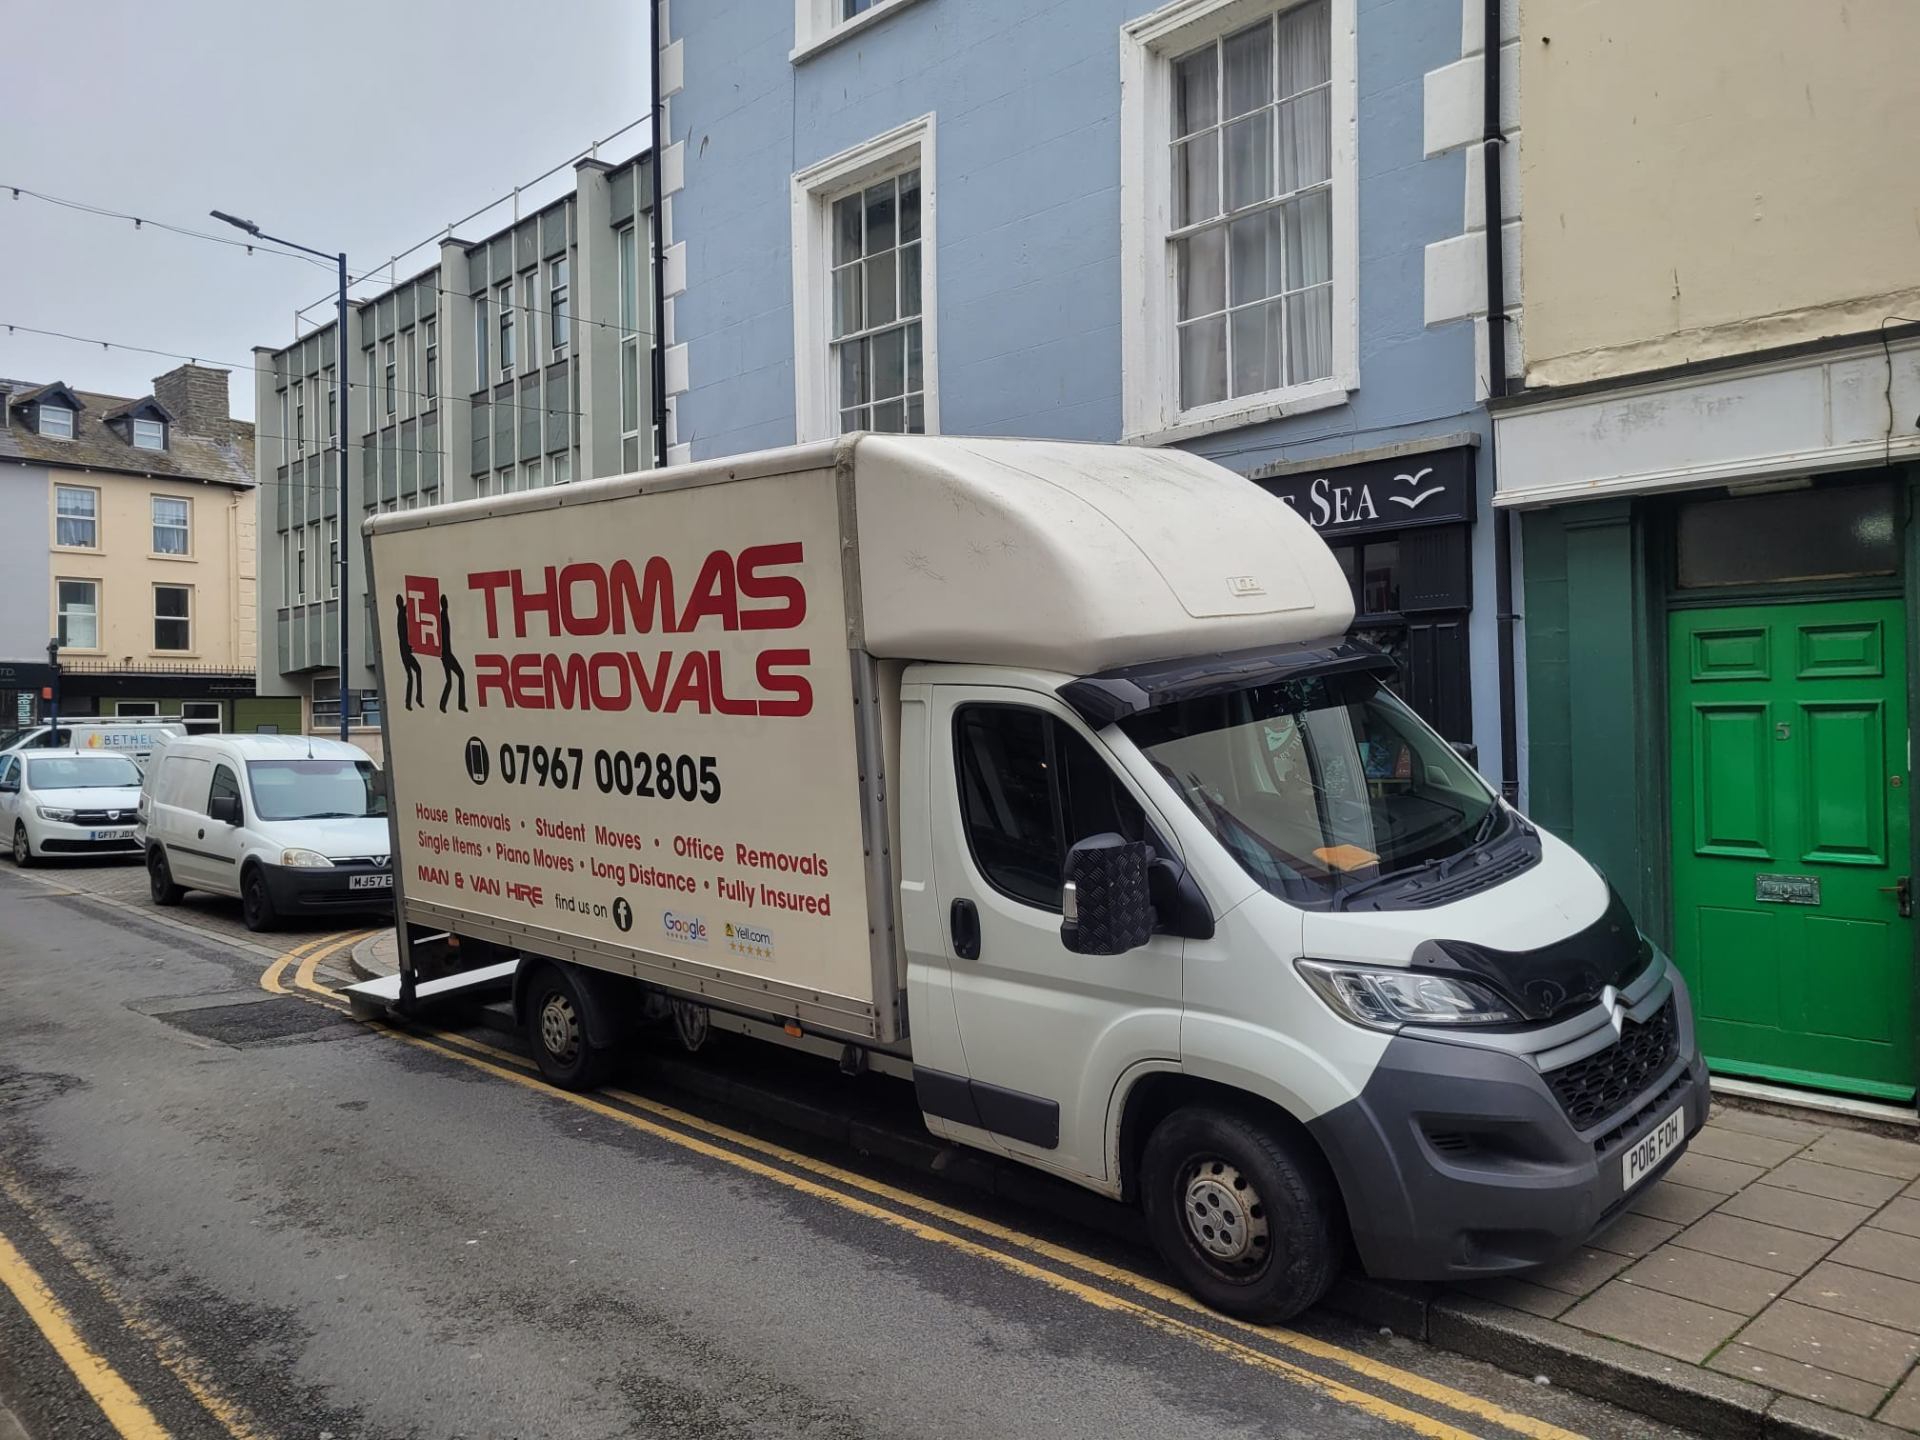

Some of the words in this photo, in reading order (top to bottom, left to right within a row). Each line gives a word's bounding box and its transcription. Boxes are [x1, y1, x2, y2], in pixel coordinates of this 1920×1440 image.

[1309, 478, 1379, 526] SEA
[467, 542, 807, 639] THOMAS
[474, 649, 814, 717] REMOVALS
[17, 693, 35, 725] Remain
[104, 735, 153, 745] BETHEL
[1776, 722, 1790, 741] 5
[500, 743, 583, 790] 07967
[595, 749, 721, 804] 002805
[416, 803, 448, 823] House
[455, 808, 511, 832] Removals
[535, 817, 586, 843] Student
[595, 826, 642, 850] Moves
[673, 835, 725, 862] Office
[736, 843, 829, 878] Removals
[354, 876, 383, 887] MJ57
[418, 831, 450, 855] Single
[452, 836, 482, 857] Items
[496, 843, 530, 865] Piano
[533, 848, 574, 873] Moves
[591, 857, 625, 887] Long
[629, 862, 696, 893] Distance
[717, 876, 755, 908] Fully
[760, 883, 831, 917] Insured
[418, 865, 449, 886] MAN
[455, 872, 465, 889] &
[470, 874, 500, 896] VAN
[506, 881, 544, 909] HIRE
[554, 893, 575, 912] find
[578, 901, 590, 915] us
[593, 903, 608, 919] on
[664, 911, 706, 939] Google
[735, 925, 771, 944] Yell.com
[1630, 1136, 1656, 1179] PO16
[1658, 1115, 1678, 1155] FOH
